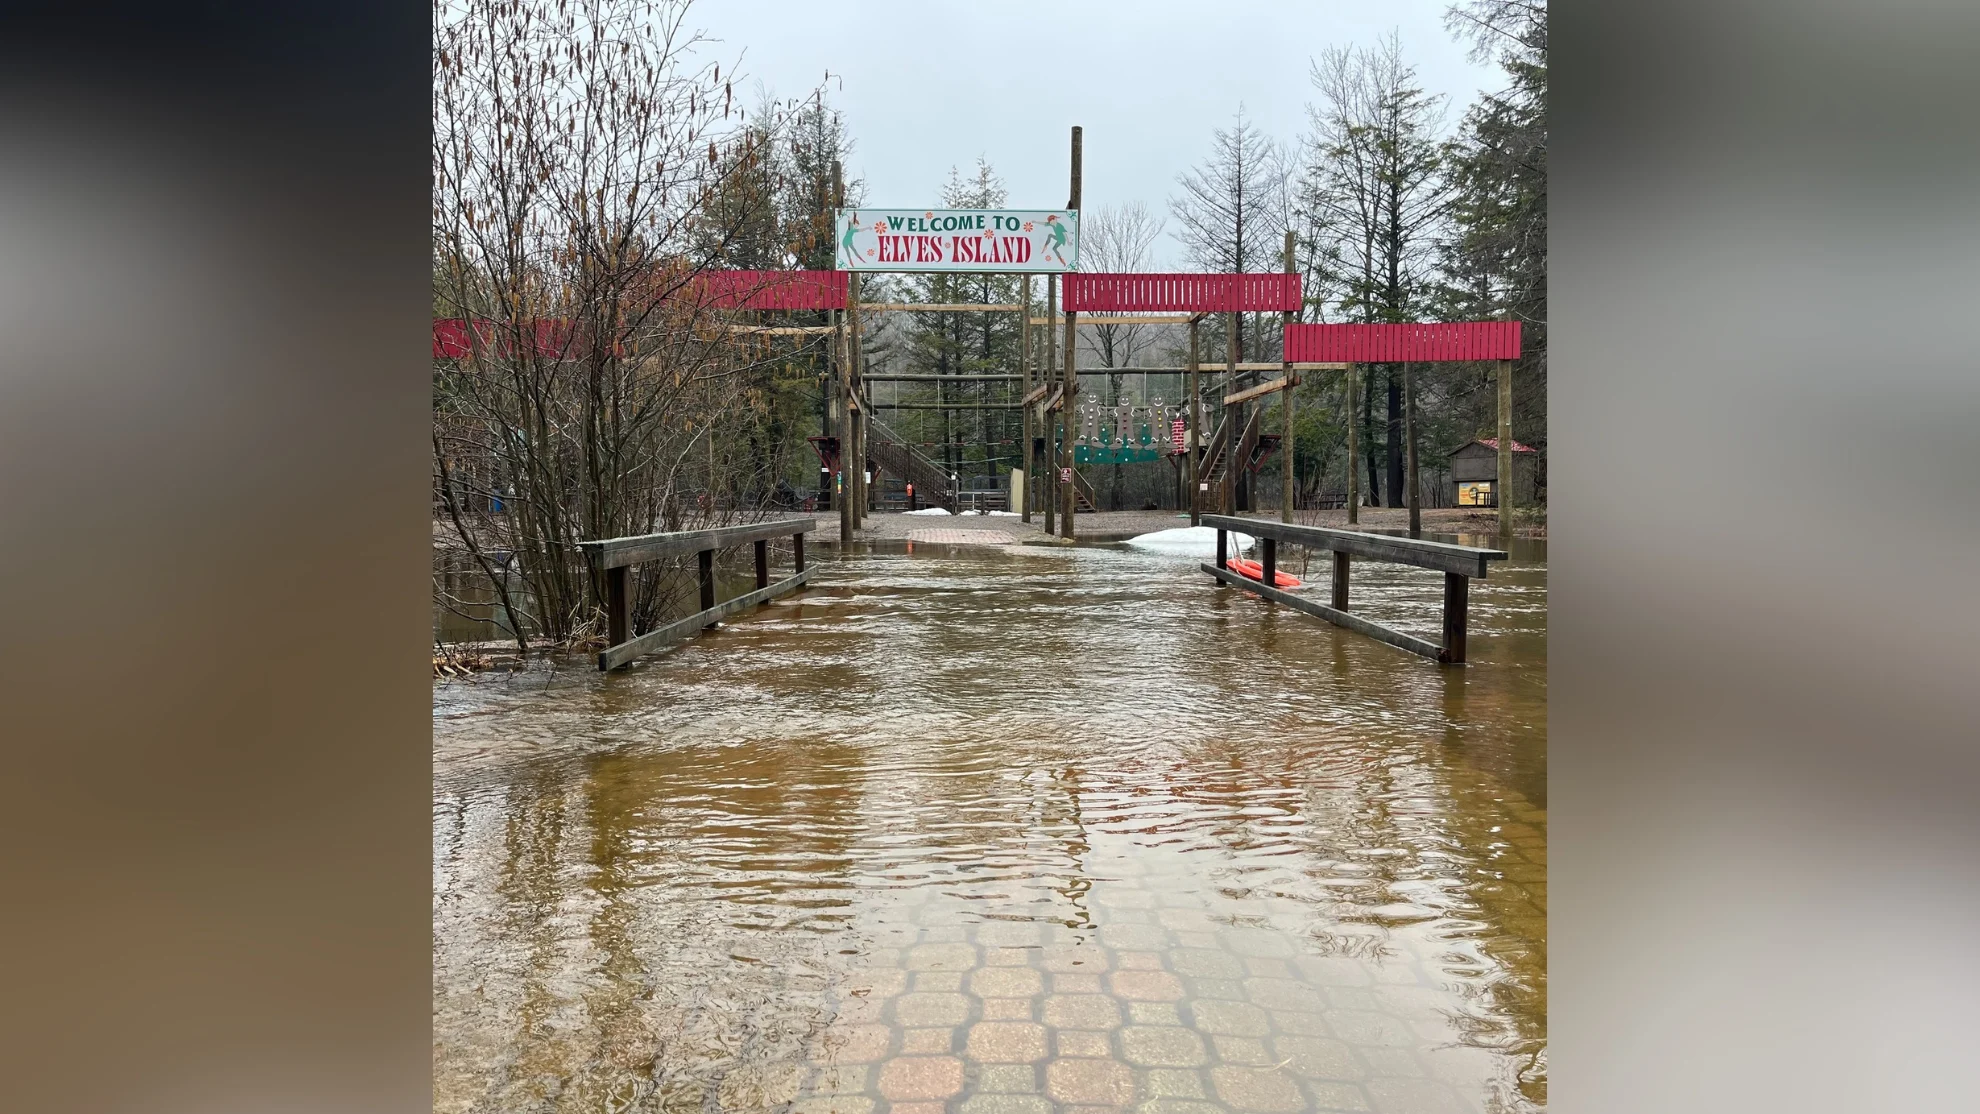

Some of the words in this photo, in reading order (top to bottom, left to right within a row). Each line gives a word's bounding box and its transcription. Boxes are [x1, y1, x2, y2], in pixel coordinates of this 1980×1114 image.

[887, 215, 985, 232] WELCOME
[992, 215, 1020, 231] TO
[877, 235, 943, 263] ELVES
[952, 236, 1031, 264] ISLAND
